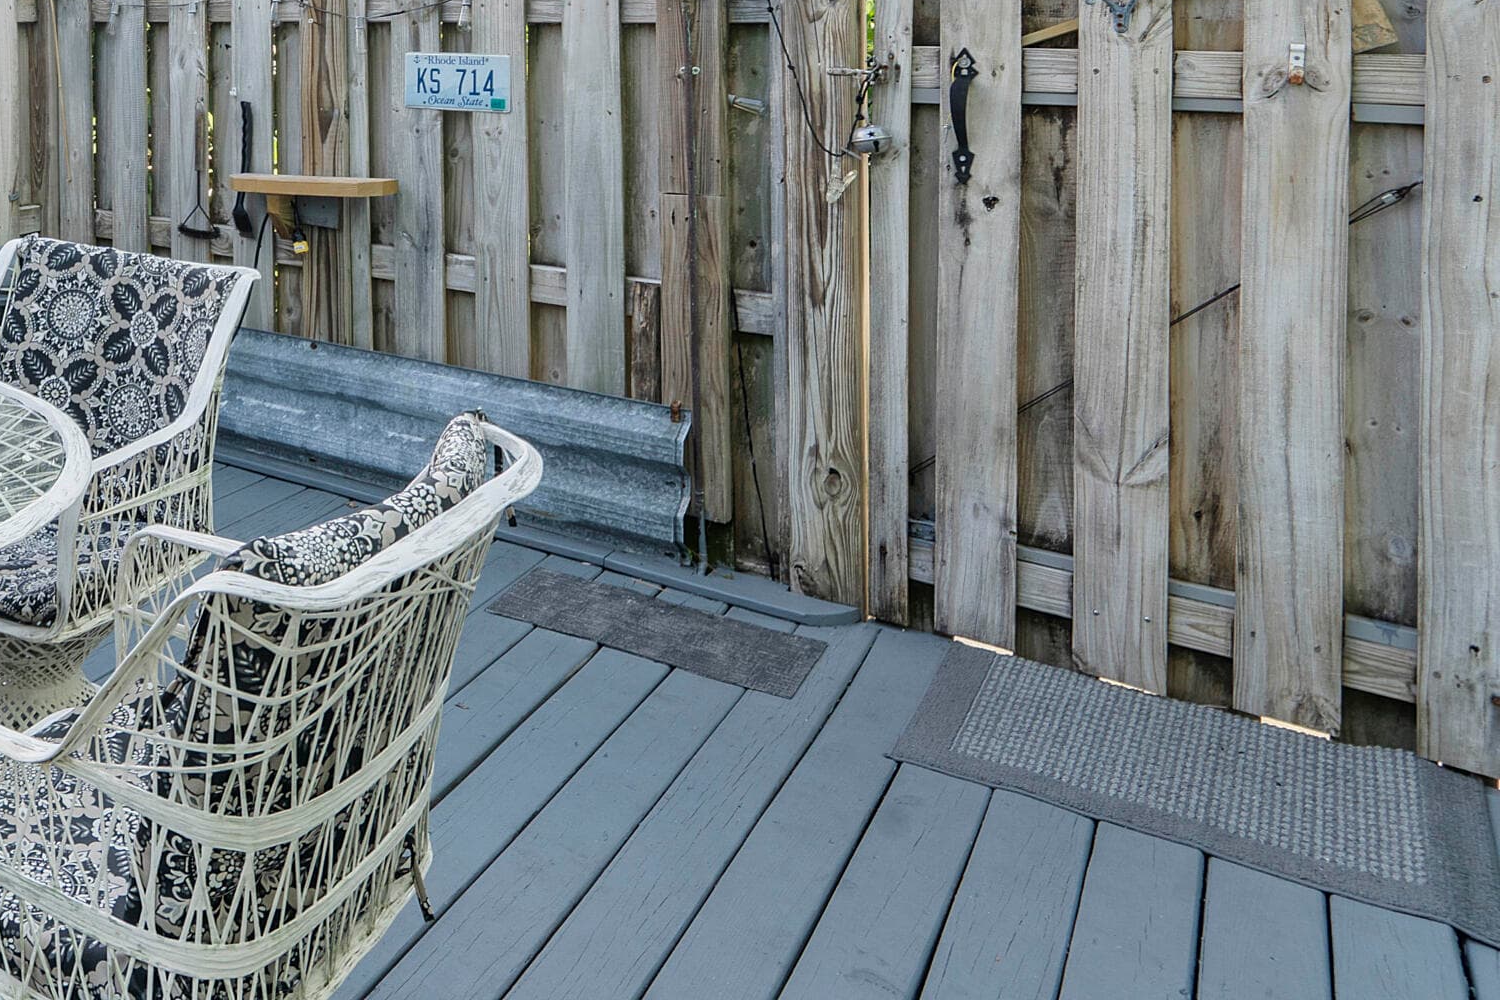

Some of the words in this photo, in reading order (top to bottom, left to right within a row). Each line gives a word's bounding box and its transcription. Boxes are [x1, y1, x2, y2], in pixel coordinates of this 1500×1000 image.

[428, 55, 456, 65] Rhode
[458, 56, 485, 66] Island
[417, 67, 441, 94] KS
[455, 69, 494, 96] 714
[427, 95, 455, 105] Ocean
[457, 96, 484, 107] State
